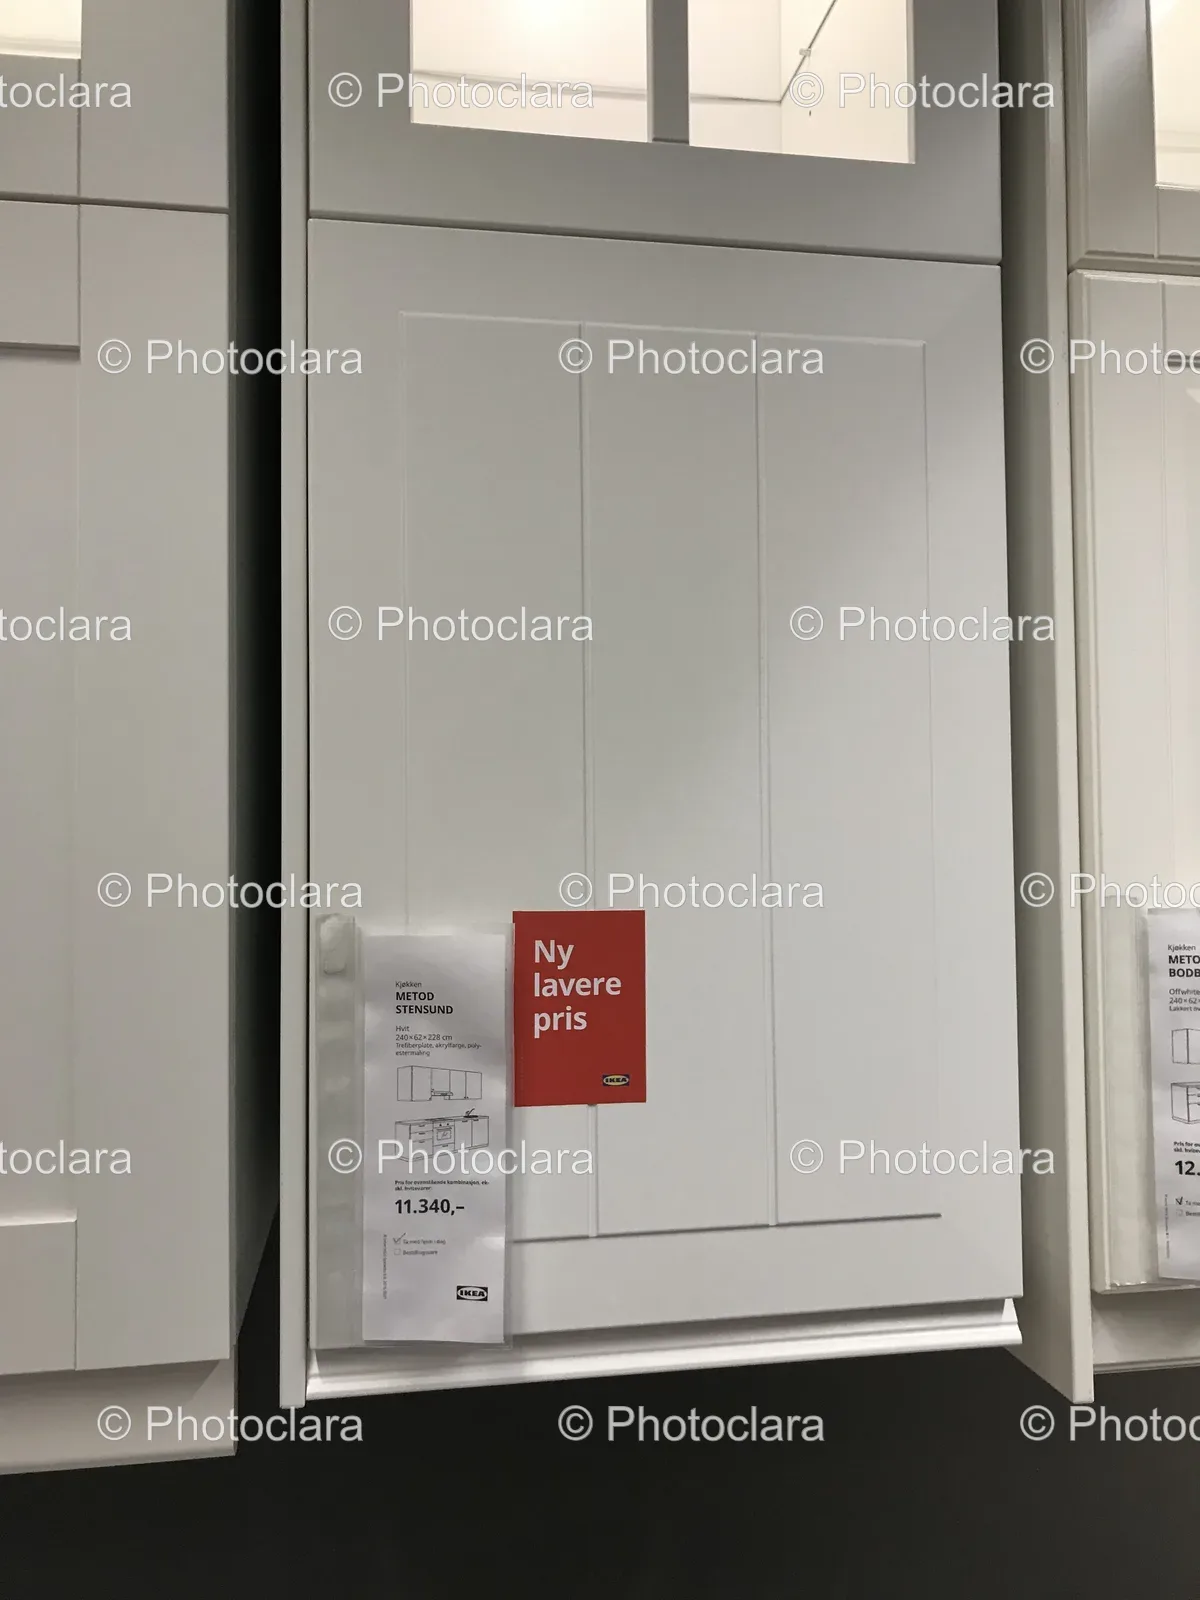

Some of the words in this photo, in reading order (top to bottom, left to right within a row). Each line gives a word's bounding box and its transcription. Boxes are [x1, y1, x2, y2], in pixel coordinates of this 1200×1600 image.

[1168, 944, 1196, 952] Kjøkken
[534, 940, 574, 970] Ny
[396, 981, 422, 989] Kjøkken
[534, 972, 622, 997] lavere
[396, 992, 434, 1000] METOD
[396, 1005, 453, 1014] STENSUND
[534, 1006, 587, 1039] pris
